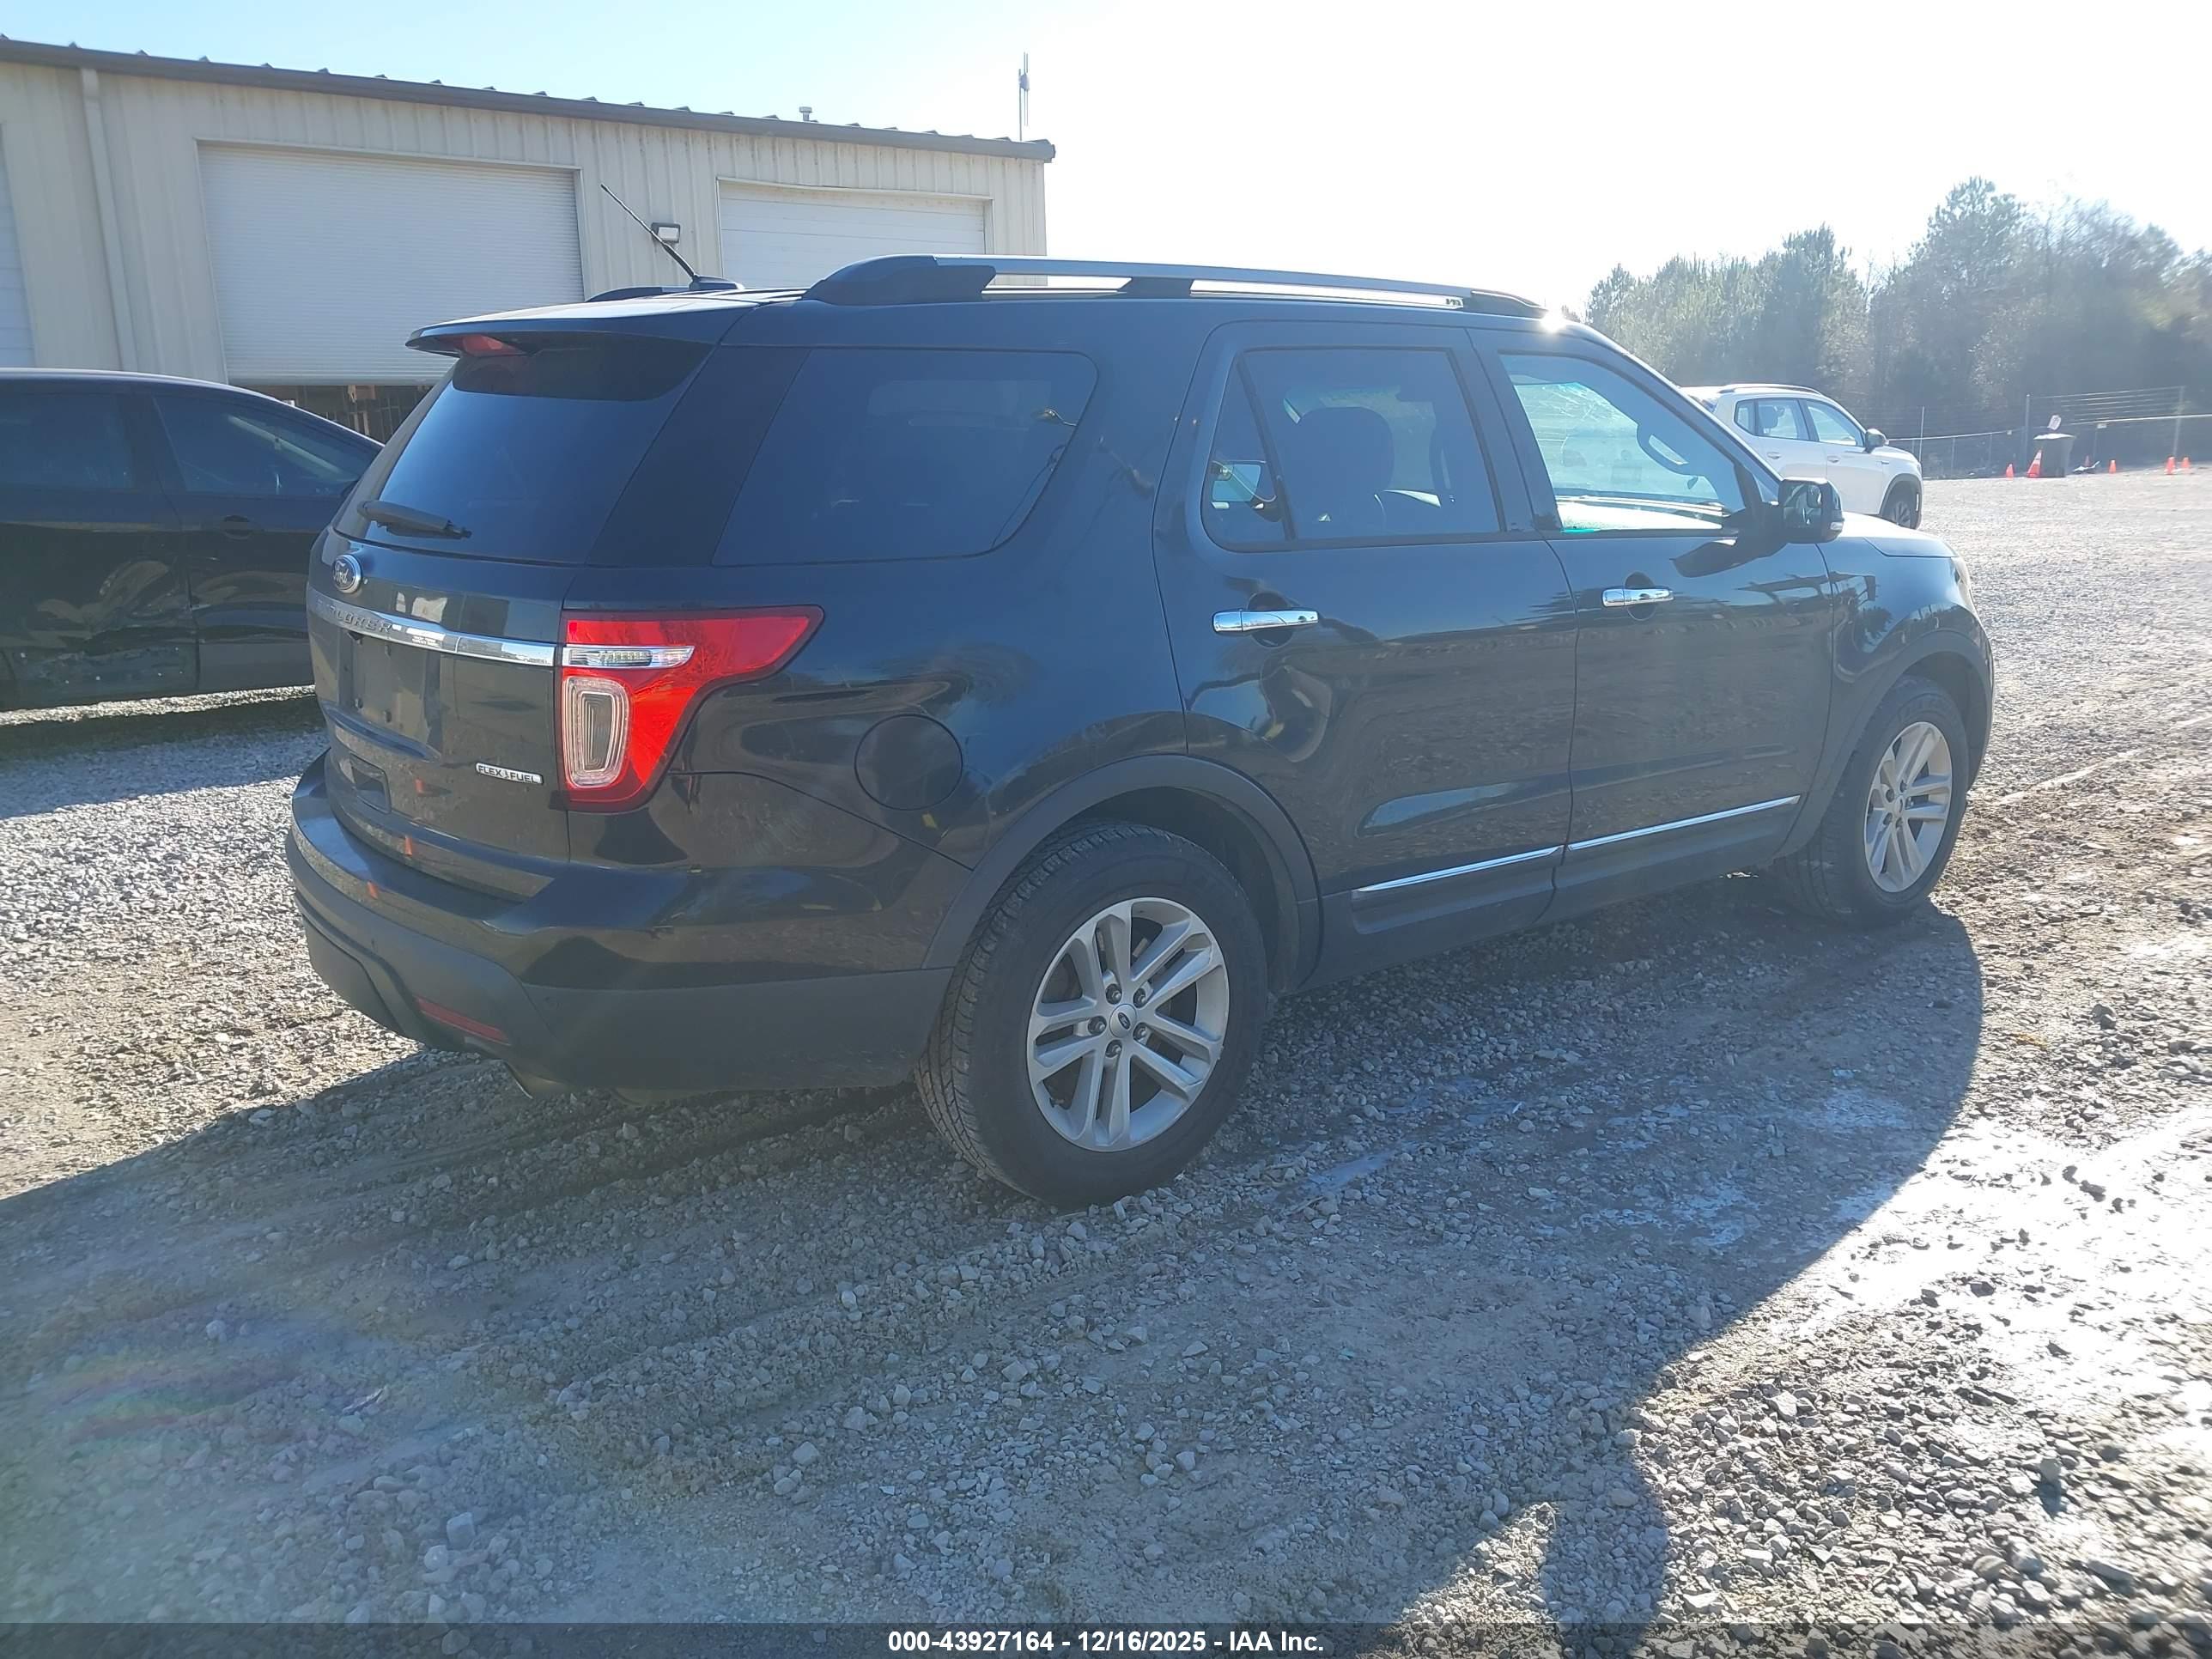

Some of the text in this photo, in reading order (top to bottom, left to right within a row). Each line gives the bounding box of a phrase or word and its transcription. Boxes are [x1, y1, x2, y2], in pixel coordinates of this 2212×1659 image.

[317, 595, 393, 633] PLORER
[477, 765, 538, 783] FLEX FUEL
